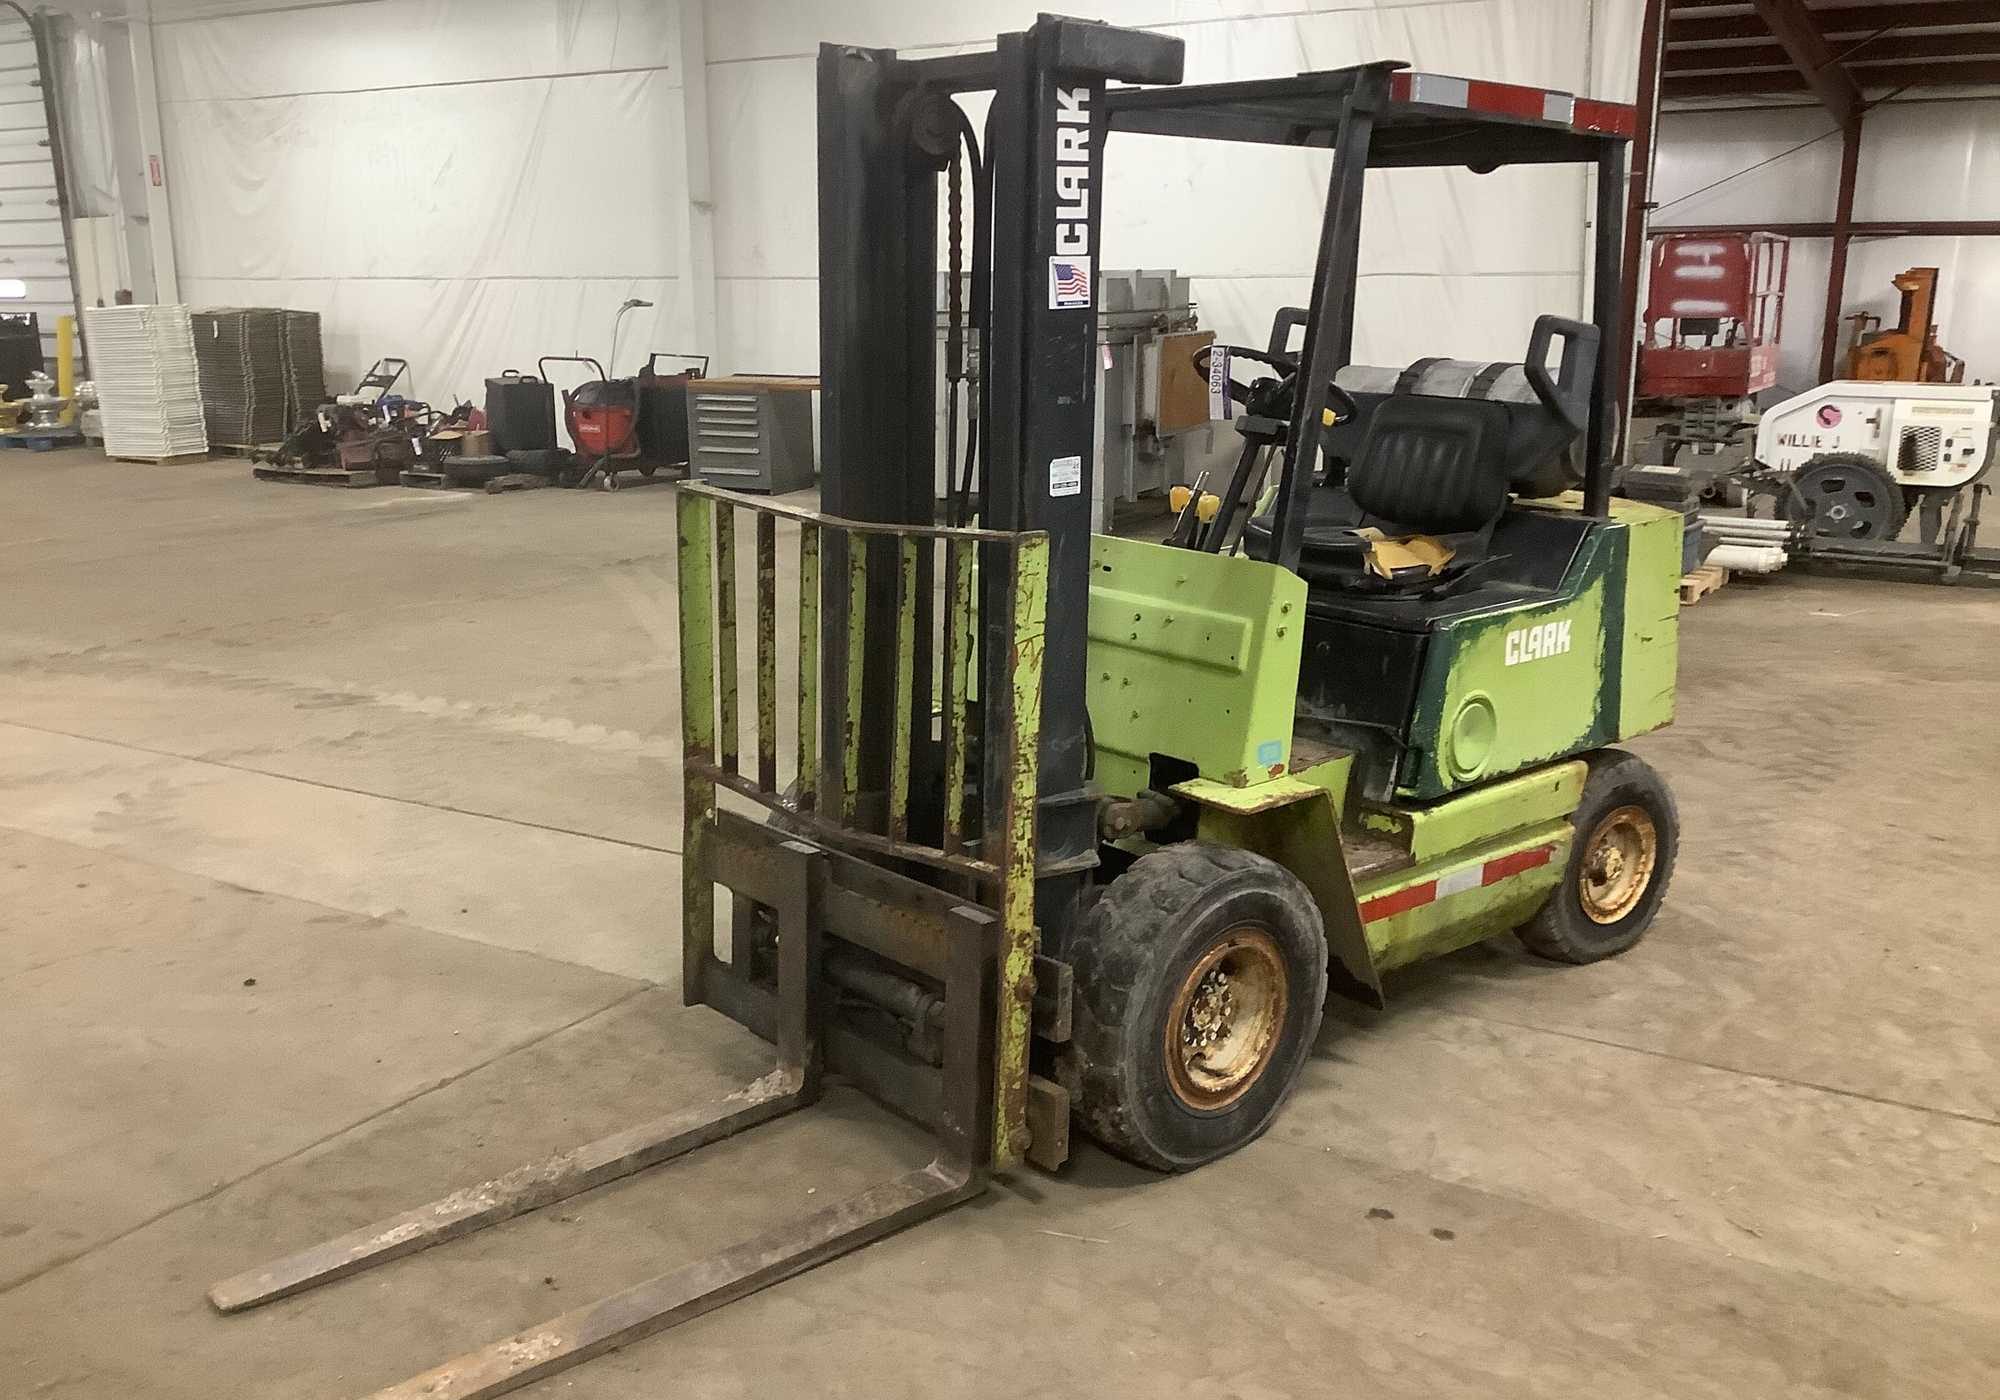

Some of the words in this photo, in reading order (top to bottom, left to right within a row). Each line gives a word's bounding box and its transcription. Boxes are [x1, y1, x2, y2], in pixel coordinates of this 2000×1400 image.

[1055, 87, 1091, 256] CLARK
[1776, 433, 1822, 448] WILLIE
[1504, 619, 1572, 667] CLARK
